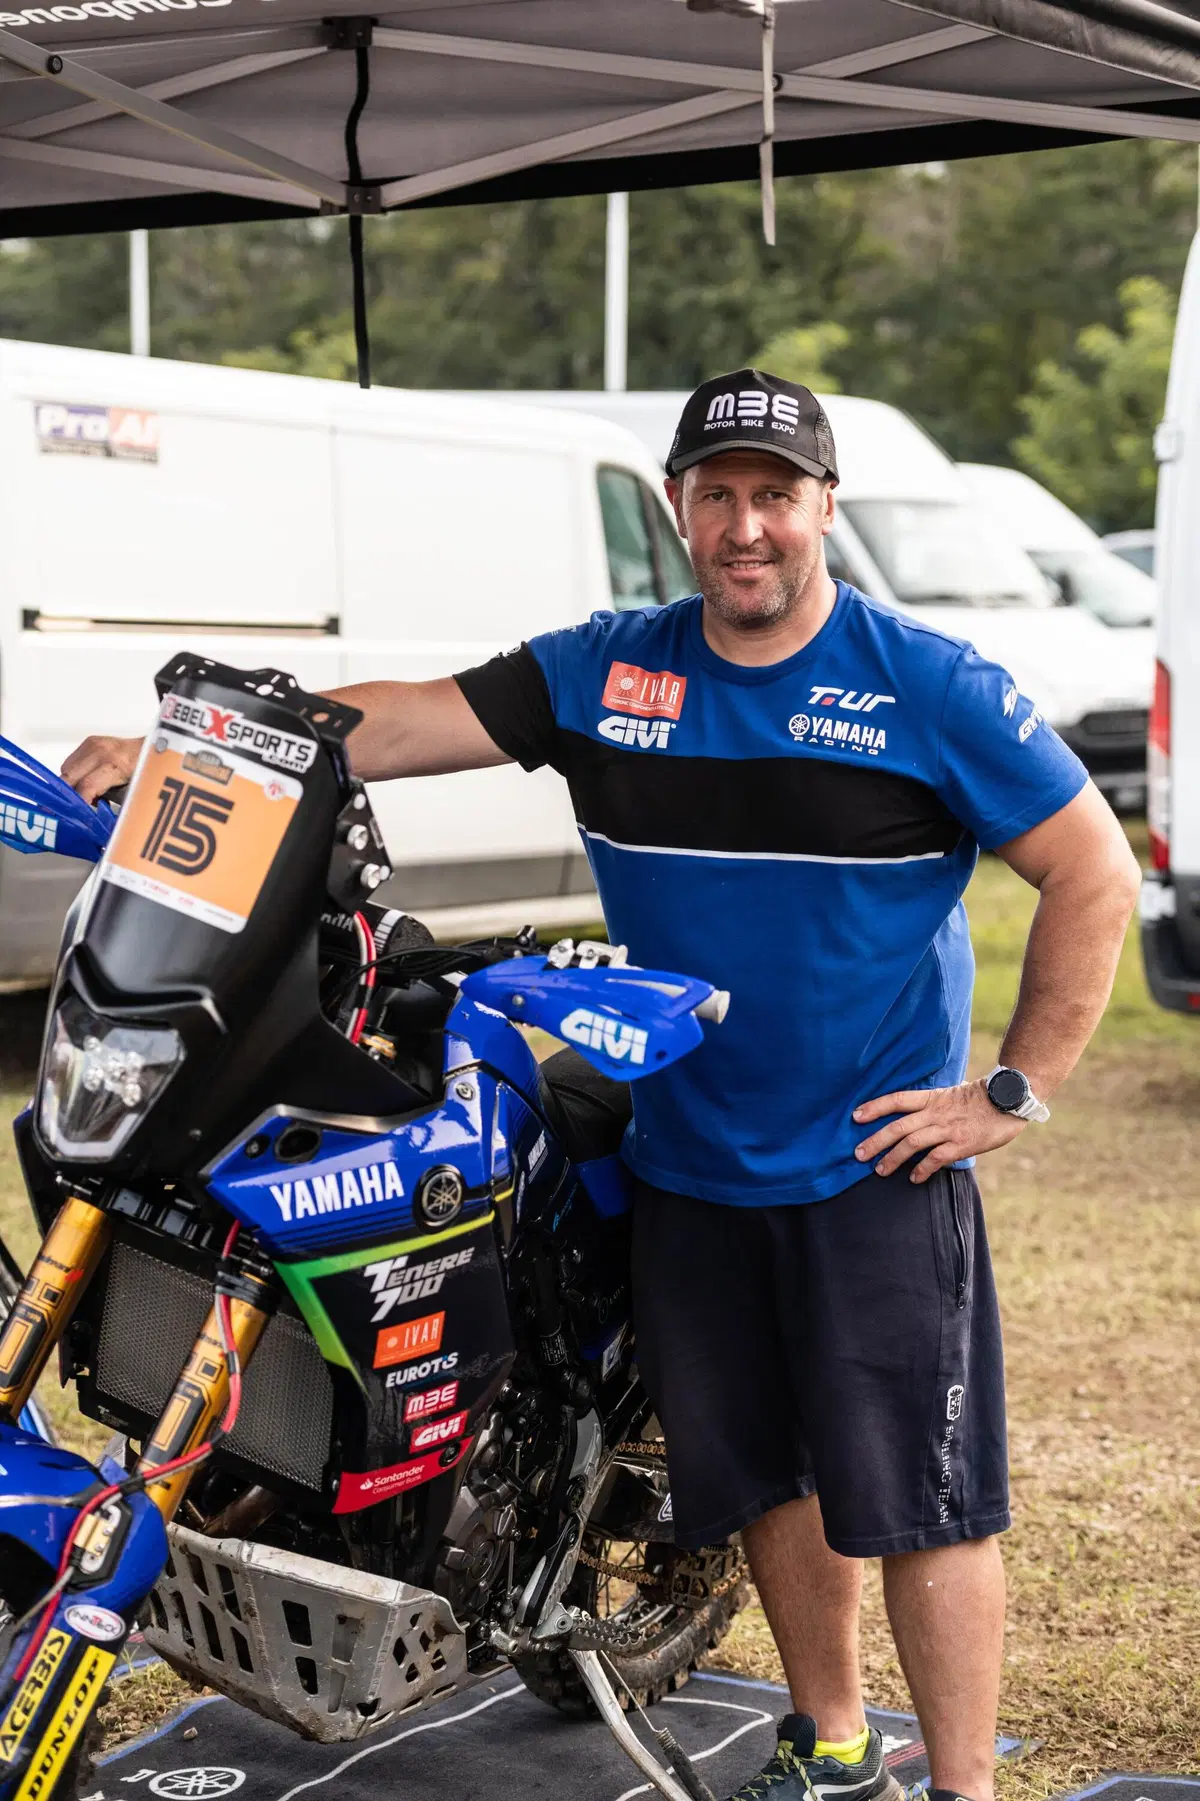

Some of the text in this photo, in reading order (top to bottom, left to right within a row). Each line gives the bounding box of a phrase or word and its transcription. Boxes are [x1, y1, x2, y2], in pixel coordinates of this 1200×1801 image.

[704, 419, 795, 435] MOTOR BIKE EXPO
[640, 677, 680, 705] IVAR
[597, 715, 671, 749] GIVI
[794, 736, 879, 756] RACING
[812, 716, 886, 749] YAMAHA
[0, 802, 58, 848] IVI
[140, 776, 235, 876] 15
[560, 1008, 648, 1065] GIVI
[269, 1161, 405, 1222] YAMAHA
[370, 1272, 446, 1323] 700
[403, 1318, 440, 1349] IVAR
[414, 1416, 461, 1447] GIVI
[941, 1425, 954, 1483] SAILING
[372, 1475, 422, 1494] Consumer Bank
[374, 1465, 425, 1487] Santander
[938, 1485, 951, 1524] TEAM
[28, 1657, 99, 1801] DUNLOP
